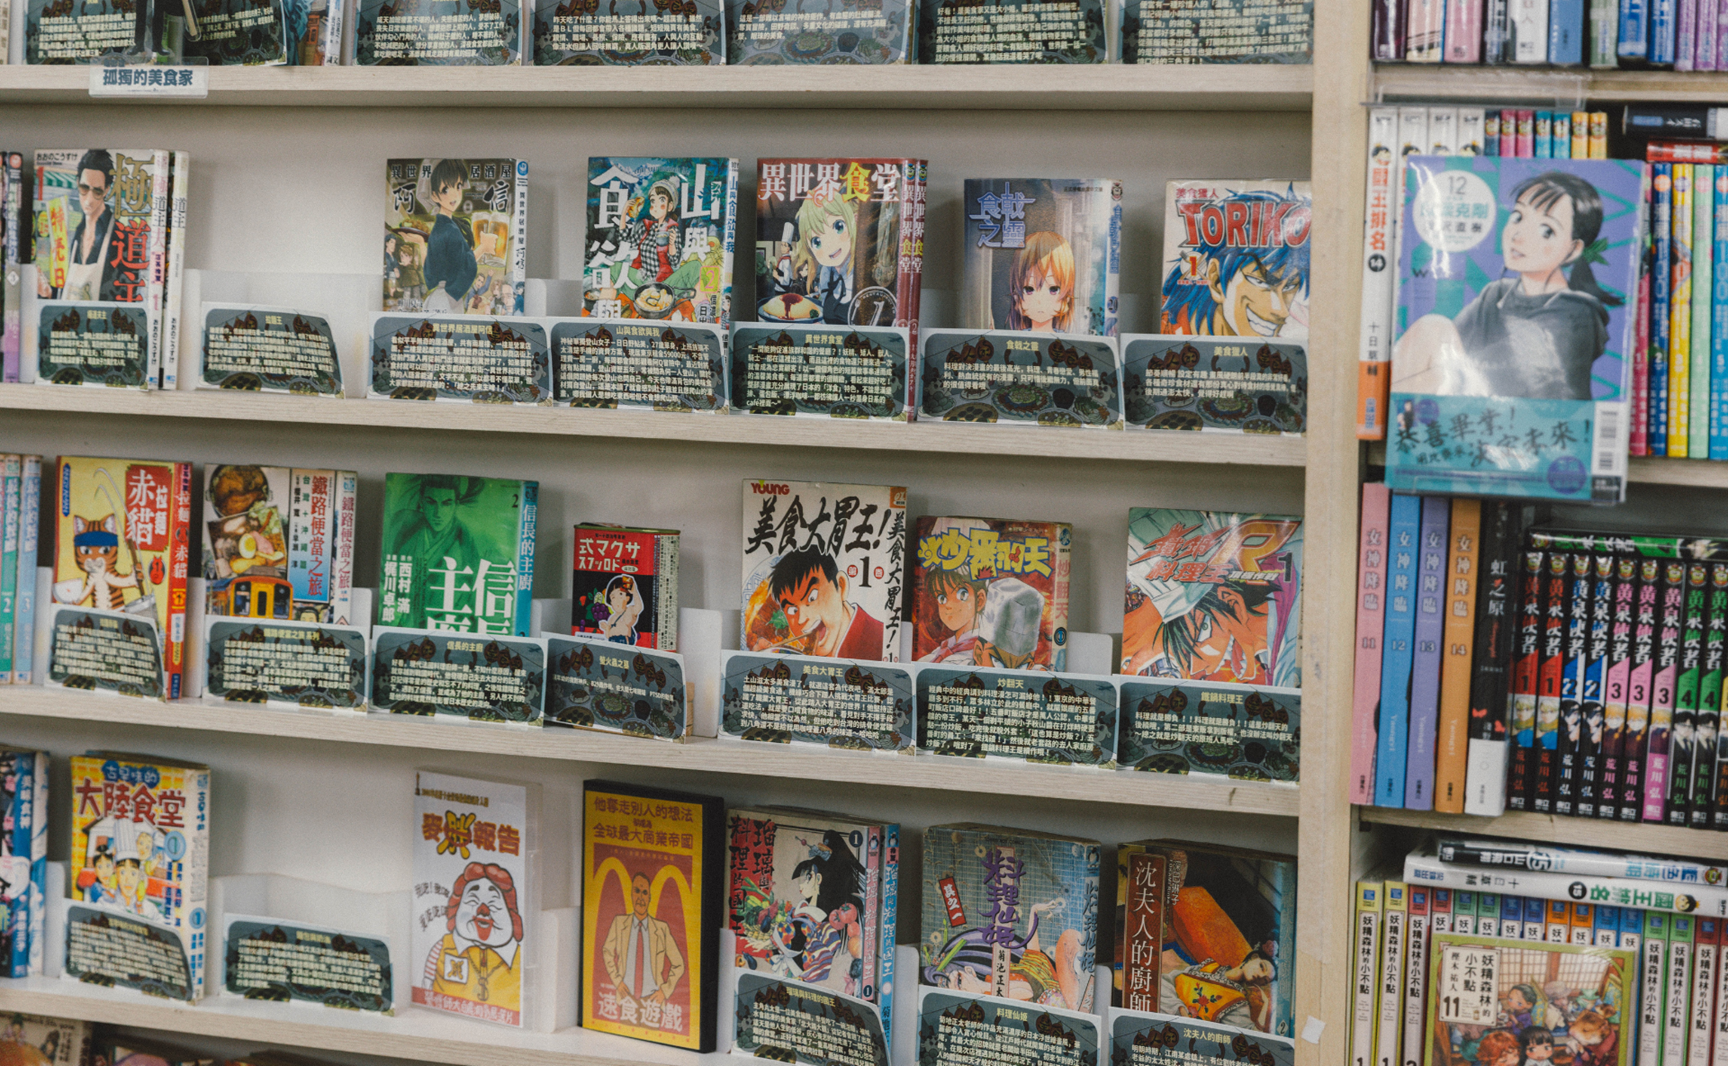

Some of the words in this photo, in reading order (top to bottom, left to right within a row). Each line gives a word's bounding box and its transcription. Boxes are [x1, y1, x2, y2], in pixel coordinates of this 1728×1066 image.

[103, 69, 193, 86] 孤獨的美食家
[36, 166, 44, 200] 1
[391, 164, 431, 179] 異世界
[470, 165, 512, 179] 居酒屋
[758, 162, 901, 202] 異世界食堂
[483, 180, 510, 212] 信
[1176, 188, 1219, 198] 美食獵人
[1448, 176, 1467, 195] 12
[1369, 168, 1389, 251] 國王排名
[900, 185, 914, 274] 異世界食堂
[912, 185, 926, 274] 異世界食堂
[1176, 200, 1311, 248] TORIKO
[1189, 256, 1197, 276] 1
[1370, 258, 1384, 269] 14
[705, 270, 715, 289] 2
[432, 323, 493, 334] 異世界居酒屋阿信
[616, 326, 660, 337] 山與食欲與我
[805, 334, 843, 345] 異世界食堂
[1006, 340, 1039, 351] 食戟之靈
[1214, 346, 1248, 357] 美食獵人
[512, 494, 519, 508] 2
[751, 483, 790, 495] YOUNG
[308, 476, 328, 596] 鐵路便當之旅
[745, 495, 891, 558] 美食大胃王！
[338, 497, 354, 589] 鐵路便當之旅
[518, 505, 537, 591] 信長的主廚
[1205, 520, 1301, 585] R
[174, 545, 189, 578] 赤貓
[859, 556, 872, 588] 1
[1145, 560, 1233, 583] 料理王
[1277, 552, 1293, 582] 1
[1364, 529, 1381, 611] 女神降臨
[1394, 531, 1411, 613] 女神降臨
[1422, 532, 1441, 614] 女神降臨
[885, 511, 905, 648] 美食大胃王！
[1453, 535, 1472, 617] 女神降臨
[1488, 559, 1508, 616] 虹之原
[382, 561, 397, 623] 梶川卓郎
[1055, 559, 1071, 619] 炒翻天
[3, 598, 11, 613] 2
[447, 641, 484, 652] 信長的主廚
[1362, 637, 1376, 649] 11
[1392, 640, 1406, 651] 12
[1420, 641, 1435, 652] 13
[1451, 645, 1466, 656] 14
[599, 656, 629, 670] 螢火蟲之墓
[803, 665, 843, 677] 美食大胃王
[997, 678, 1024, 689] 炒翻天
[1521, 675, 1528, 692] 1
[1546, 677, 1553, 693] 1
[1563, 678, 1577, 695] 2
[1585, 680, 1599, 696] 2
[1611, 682, 1621, 699] 3
[1633, 684, 1643, 701] 3
[1658, 688, 1669, 704] 3
[1201, 692, 1243, 704] 鐵鍋料理王
[1681, 689, 1692, 707] 4
[1704, 691, 1715, 708] 4
[76, 778, 186, 828] 大陸食堂
[593, 796, 694, 823] 他奪走別人的想法
[593, 823, 693, 849] 全球最大商業帝國
[977, 849, 1039, 949] 料理仙姬
[1590, 884, 1674, 909] 國王排名
[1130, 861, 1157, 1013] 沈夫人的廚師
[1360, 916, 1372, 995] 妖精森林的小不點
[1385, 914, 1400, 994] 妖精森林的小不點
[1410, 919, 1423, 998] 妖精森林的小不點
[1463, 953, 1478, 992] 小不點
[1645, 944, 1659, 1025] 妖精森林的小不點
[1479, 954, 1494, 1017] 妖精森林的
[1670, 947, 1685, 1028] 妖精森林的小不點
[1696, 949, 1711, 1030] 妖精森林的小不點
[598, 990, 682, 1032] 速食遊戲
[996, 1007, 1028, 1022] 料理仙姬
[1444, 996, 1460, 1017] 11
[1183, 1028, 1231, 1044] 沈夫人的廚師
